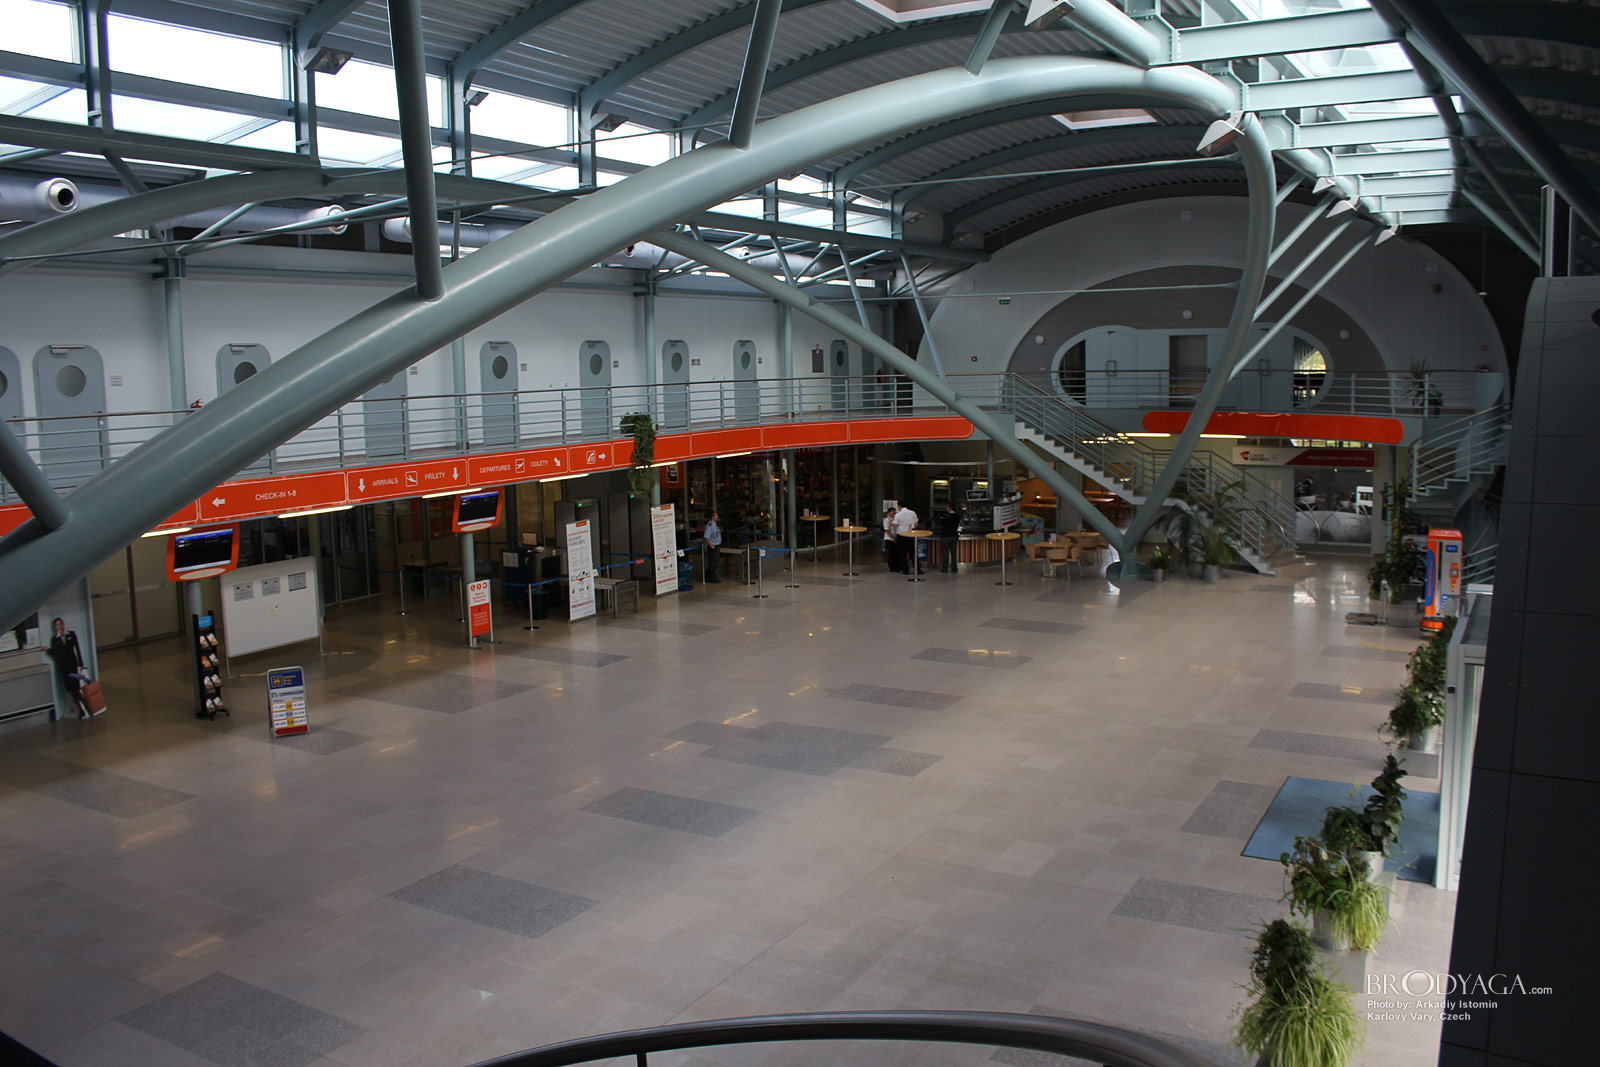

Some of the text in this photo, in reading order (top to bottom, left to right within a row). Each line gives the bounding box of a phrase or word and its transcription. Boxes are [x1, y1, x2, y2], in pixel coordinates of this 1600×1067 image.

[479, 459, 549, 474] DEPARTURES ODLETY
[372, 477, 399, 487] ARRIVALS
[255, 489, 297, 501] CHECK-IN 1-8
